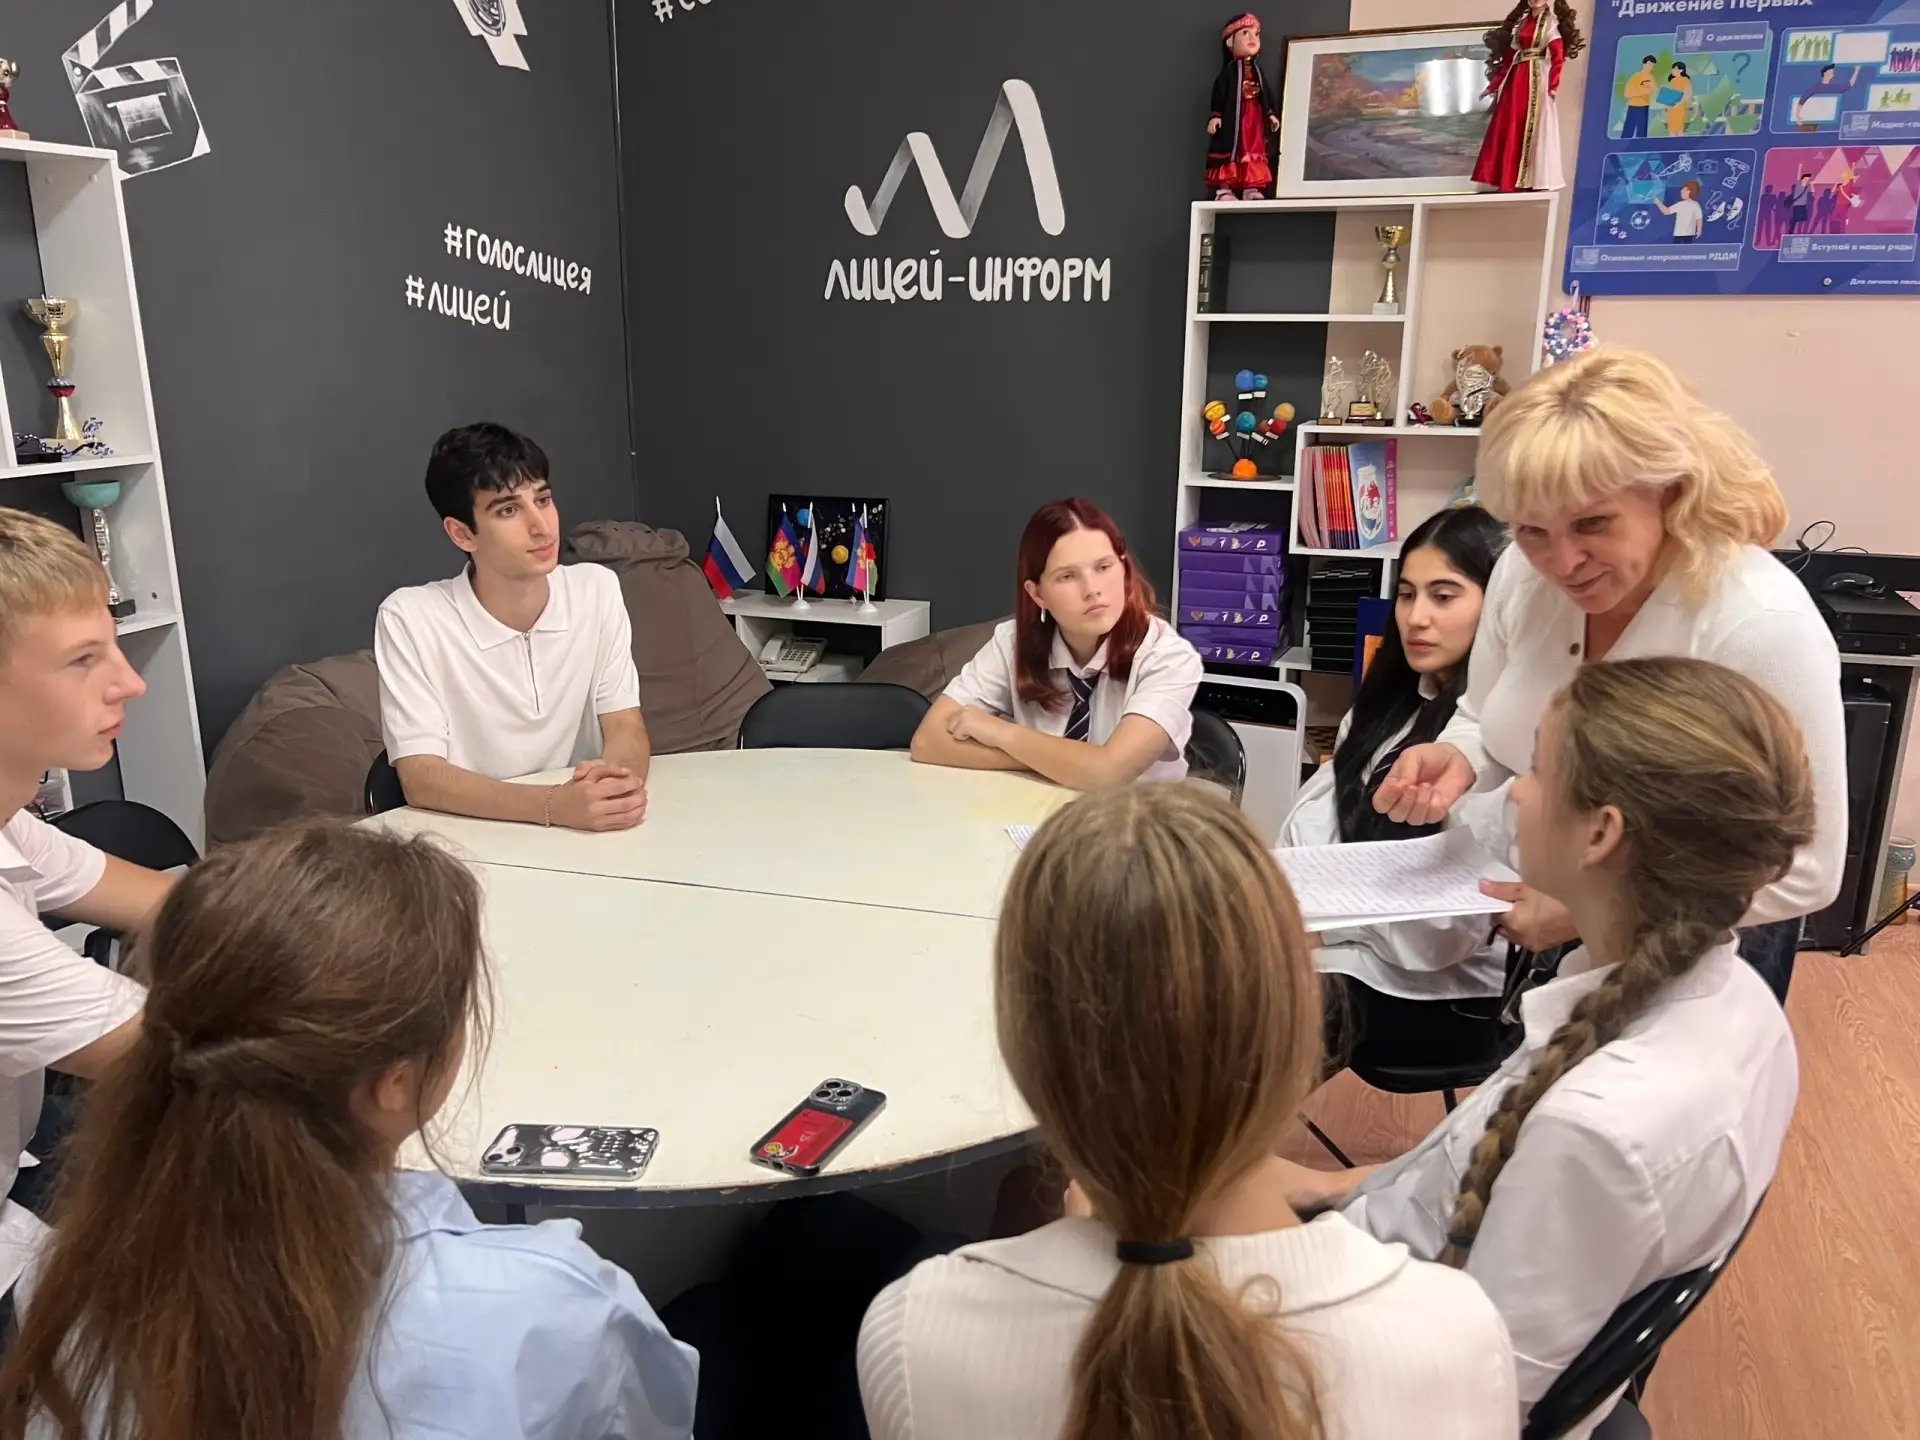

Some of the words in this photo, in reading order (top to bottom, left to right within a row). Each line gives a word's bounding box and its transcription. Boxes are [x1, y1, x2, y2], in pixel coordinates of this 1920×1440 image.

[443, 222, 592, 295] #голослицея
[1708, 251, 1738, 261] РДДМ
[1811, 243, 1850, 253] Вступай
[1887, 244, 1914, 253] ряды
[405, 274, 511, 331] #лицей
